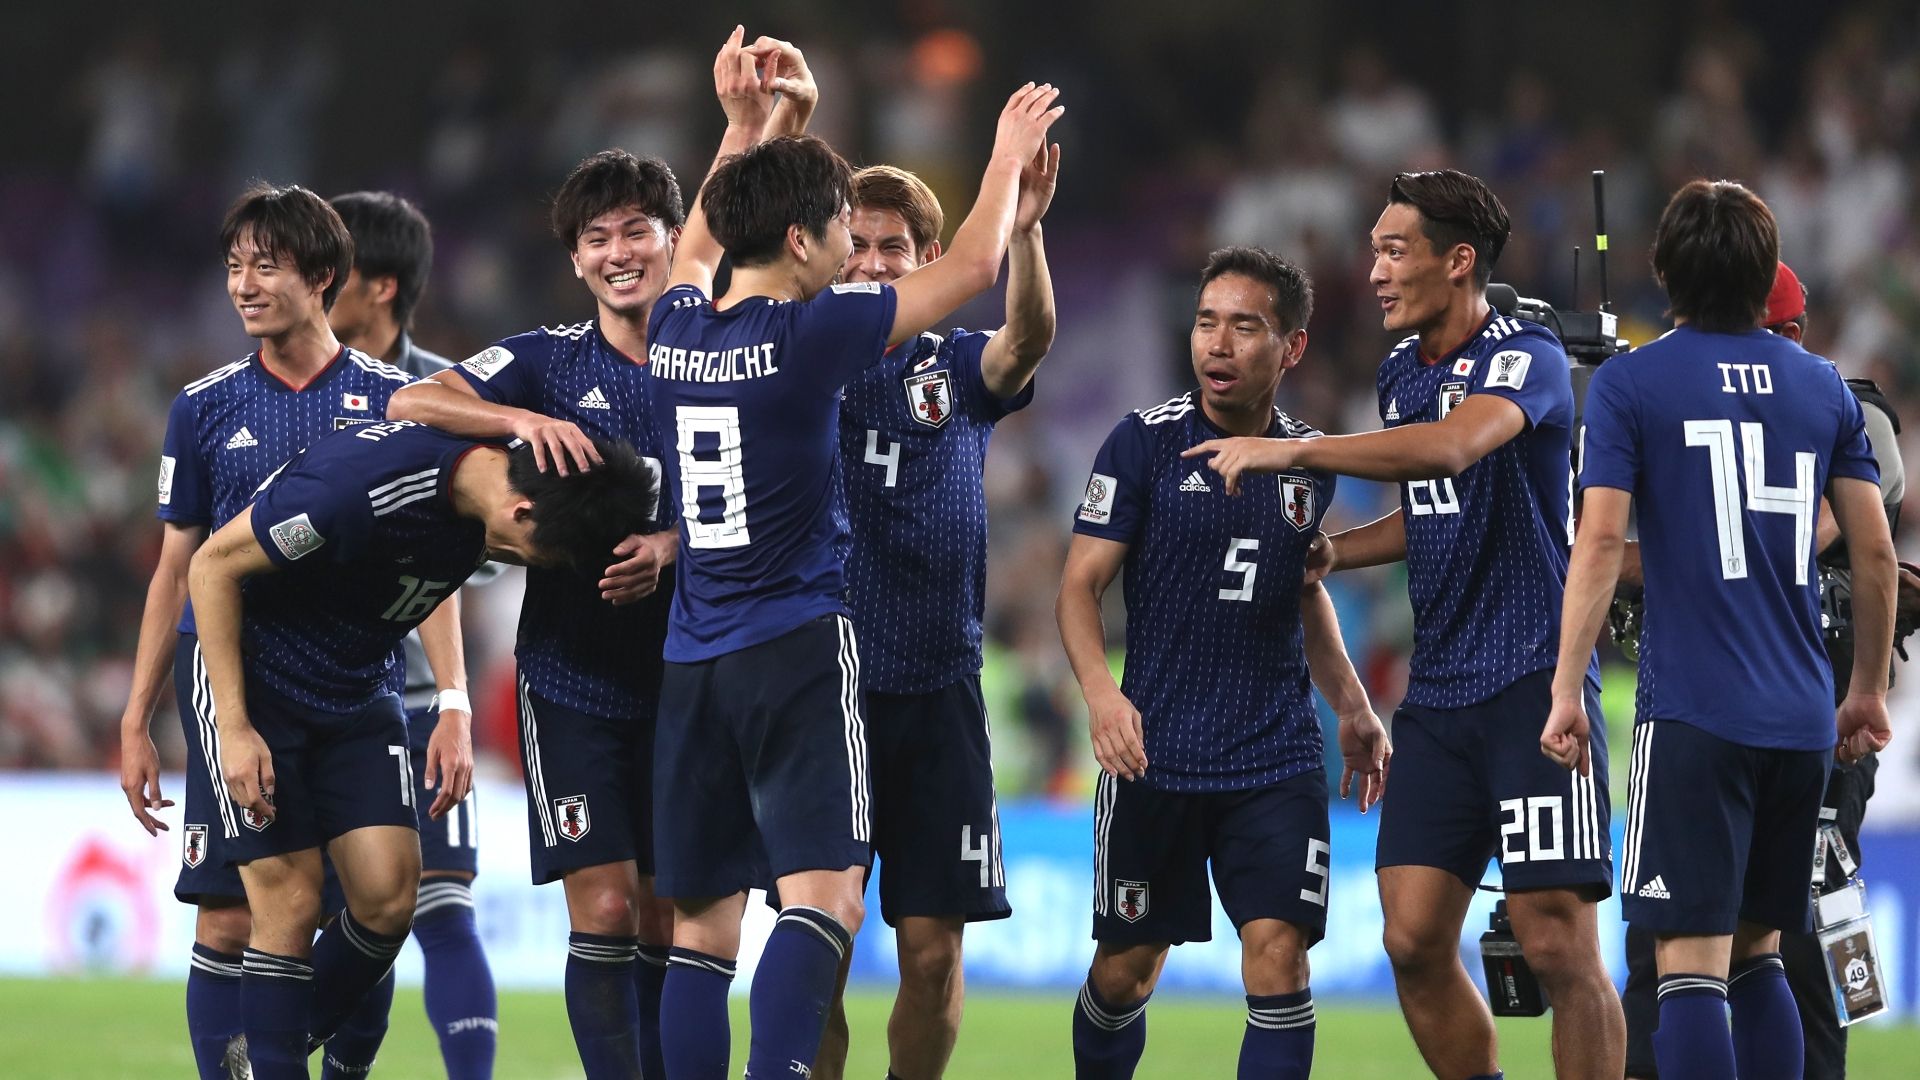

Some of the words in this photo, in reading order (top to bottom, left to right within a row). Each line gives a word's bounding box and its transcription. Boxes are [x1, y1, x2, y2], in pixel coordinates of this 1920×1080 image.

[649, 342, 779, 382] HARAGUCHI
[916, 374, 938, 383] JAPAN
[1717, 362, 1773, 394] ITO
[578, 400, 610, 410] adidas
[226, 439, 258, 450] adidas
[864, 430, 900, 487] 4
[676, 406, 750, 549] 8
[1179, 483, 1211, 493] adidas
[1408, 478, 1460, 515] 20
[1684, 419, 1816, 586] 14
[1219, 537, 1259, 601] 5
[381, 575, 450, 622] 16
[1500, 796, 1563, 864] 20
[961, 825, 988, 888] 4
[1301, 838, 1330, 906] 5
[1639, 888, 1671, 900] adidas
[1850, 966, 1866, 983] 49
